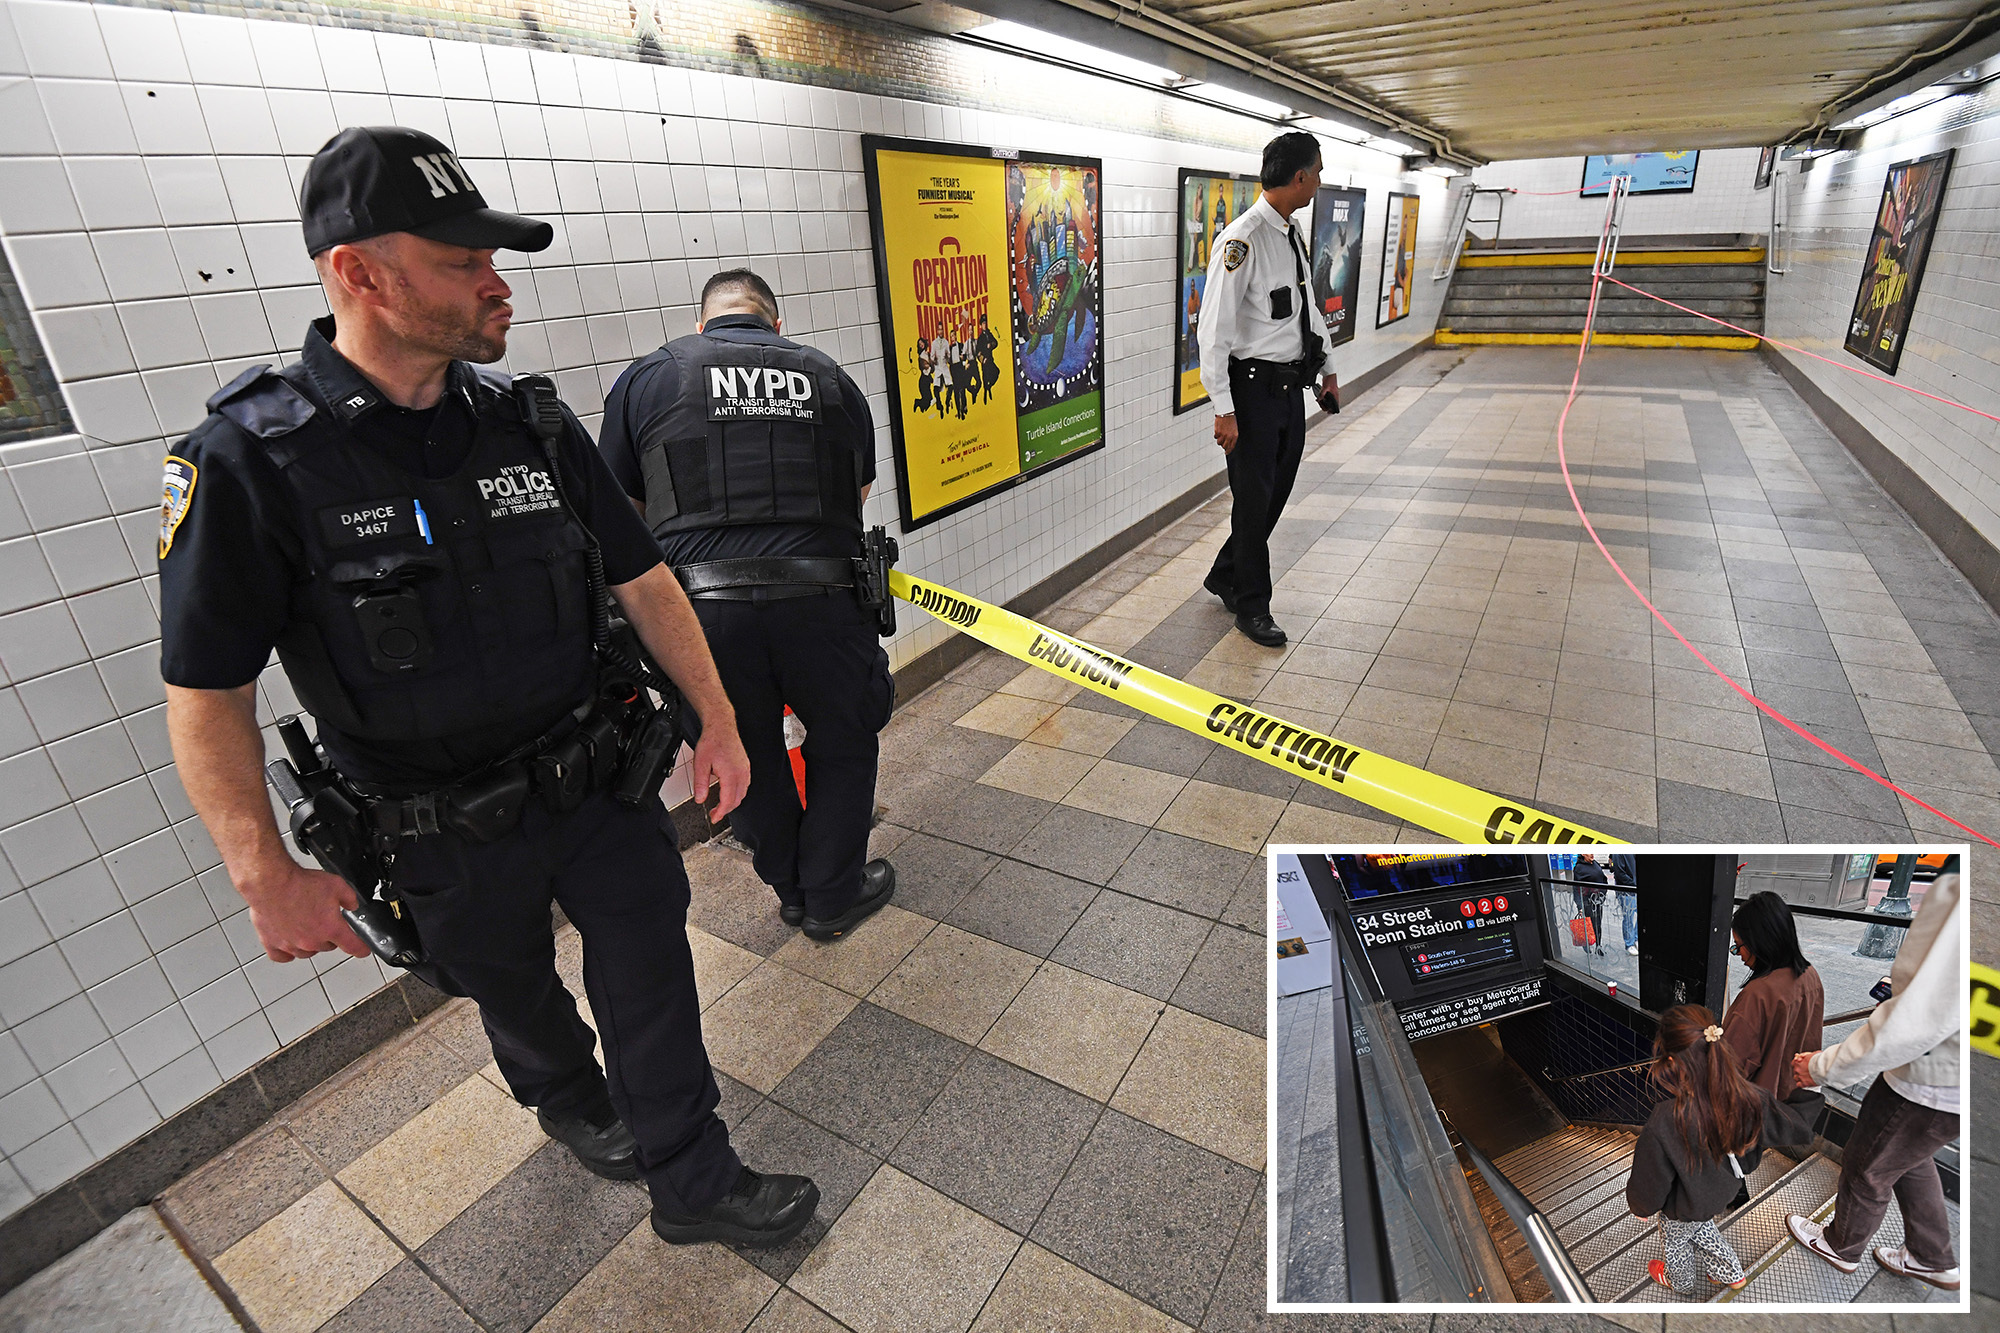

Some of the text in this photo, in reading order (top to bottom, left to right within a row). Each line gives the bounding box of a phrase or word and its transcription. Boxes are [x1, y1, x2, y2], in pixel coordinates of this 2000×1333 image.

[918, 189, 947, 200] FUNNIEST
[1332, 208, 1350, 222] IMAX
[913, 254, 988, 305] OPERATION
[710, 367, 812, 401] NYPD
[346, 396, 366, 408] TB
[726, 398, 802, 409] TRANSIT BUREAU
[714, 407, 814, 419] ANTI TERRORISM UNIT
[1026, 425, 1045, 441] Turtle
[1045, 418, 1063, 434] Island
[1063, 408, 1096, 427] Connections
[947, 452, 961, 462] NEW
[963, 442, 990, 456] MUSICAL
[500, 464, 529, 476] NYPD
[477, 471, 555, 500] POLICE
[495, 492, 554, 507] TRANSIT BUREAU
[341, 506, 396, 525] DAPICE
[491, 507, 508, 518] ANTI
[509, 502, 549, 515] TERRORISM
[356, 521, 389, 537] 3467
[910, 584, 982, 628] CAUTION
[1028, 632, 1133, 691] CAUTION
[1206, 702, 1361, 784] CAUTION
[1377, 854, 1434, 866] manhattan
[1464, 898, 1505, 914] 1 2 3
[1356, 907, 1433, 931] 34 Street
[1496, 915, 1512, 924] LIRR
[1363, 929, 1407, 947] Penn
[1409, 918, 1464, 938] Station
[1427, 951, 1443, 959] South
[1443, 949, 1456, 957] Ferry
[1400, 980, 1541, 1024] Enter with or buy MetroCard at
[1404, 989, 1541, 1032] all times or see agent on LIRR
[1407, 1012, 1482, 1040] concourse level
